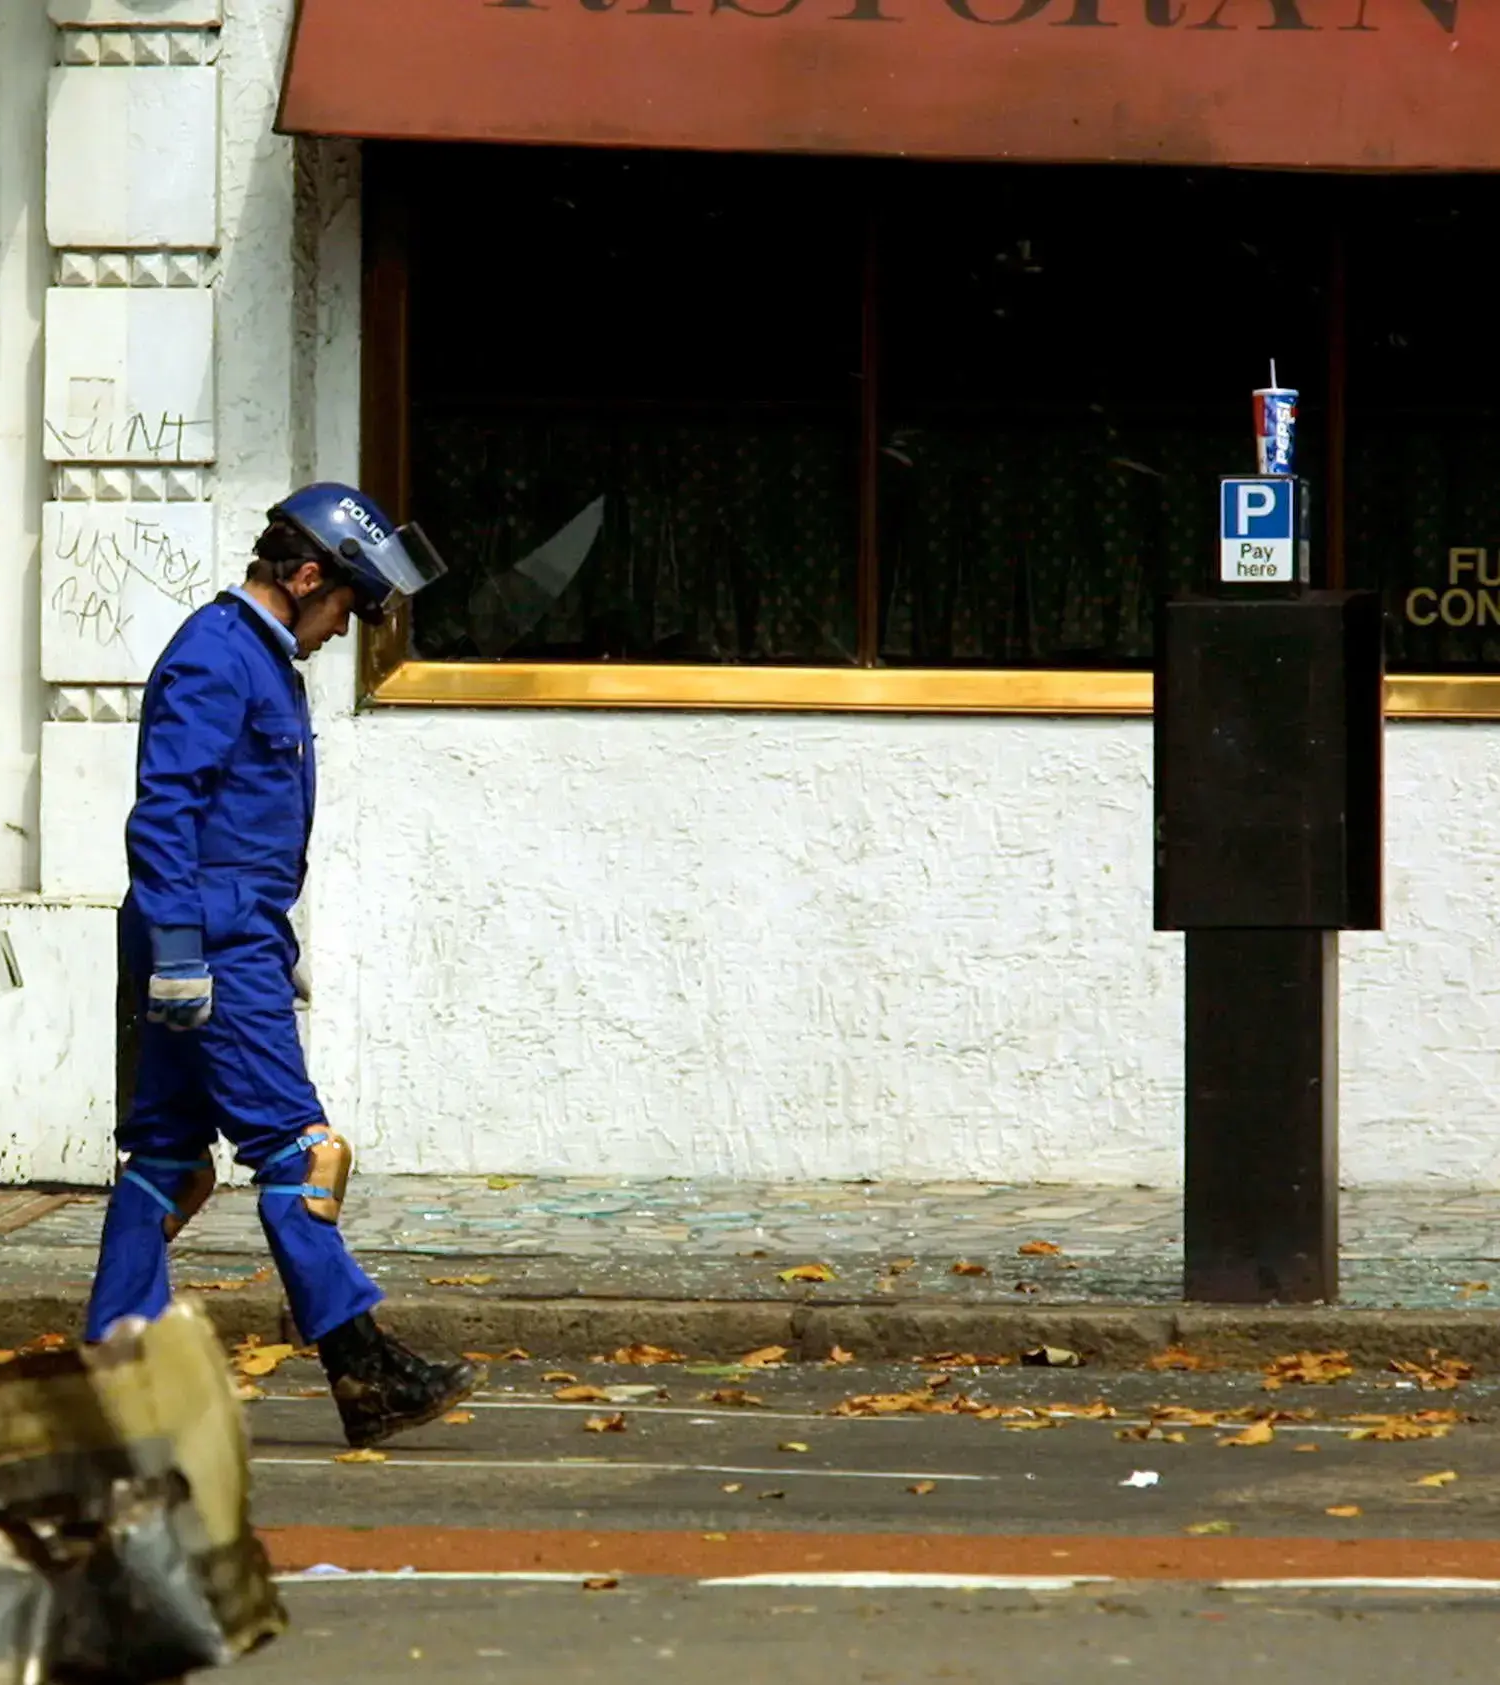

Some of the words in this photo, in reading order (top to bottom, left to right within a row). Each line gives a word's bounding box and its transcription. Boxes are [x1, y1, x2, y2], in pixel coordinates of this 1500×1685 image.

[1276, 402, 1296, 465] PEPSI
[338, 497, 391, 554] POLICE
[1236, 484, 1277, 536] P
[1237, 562, 1277, 577] here
[1240, 543, 1275, 562] Pay
